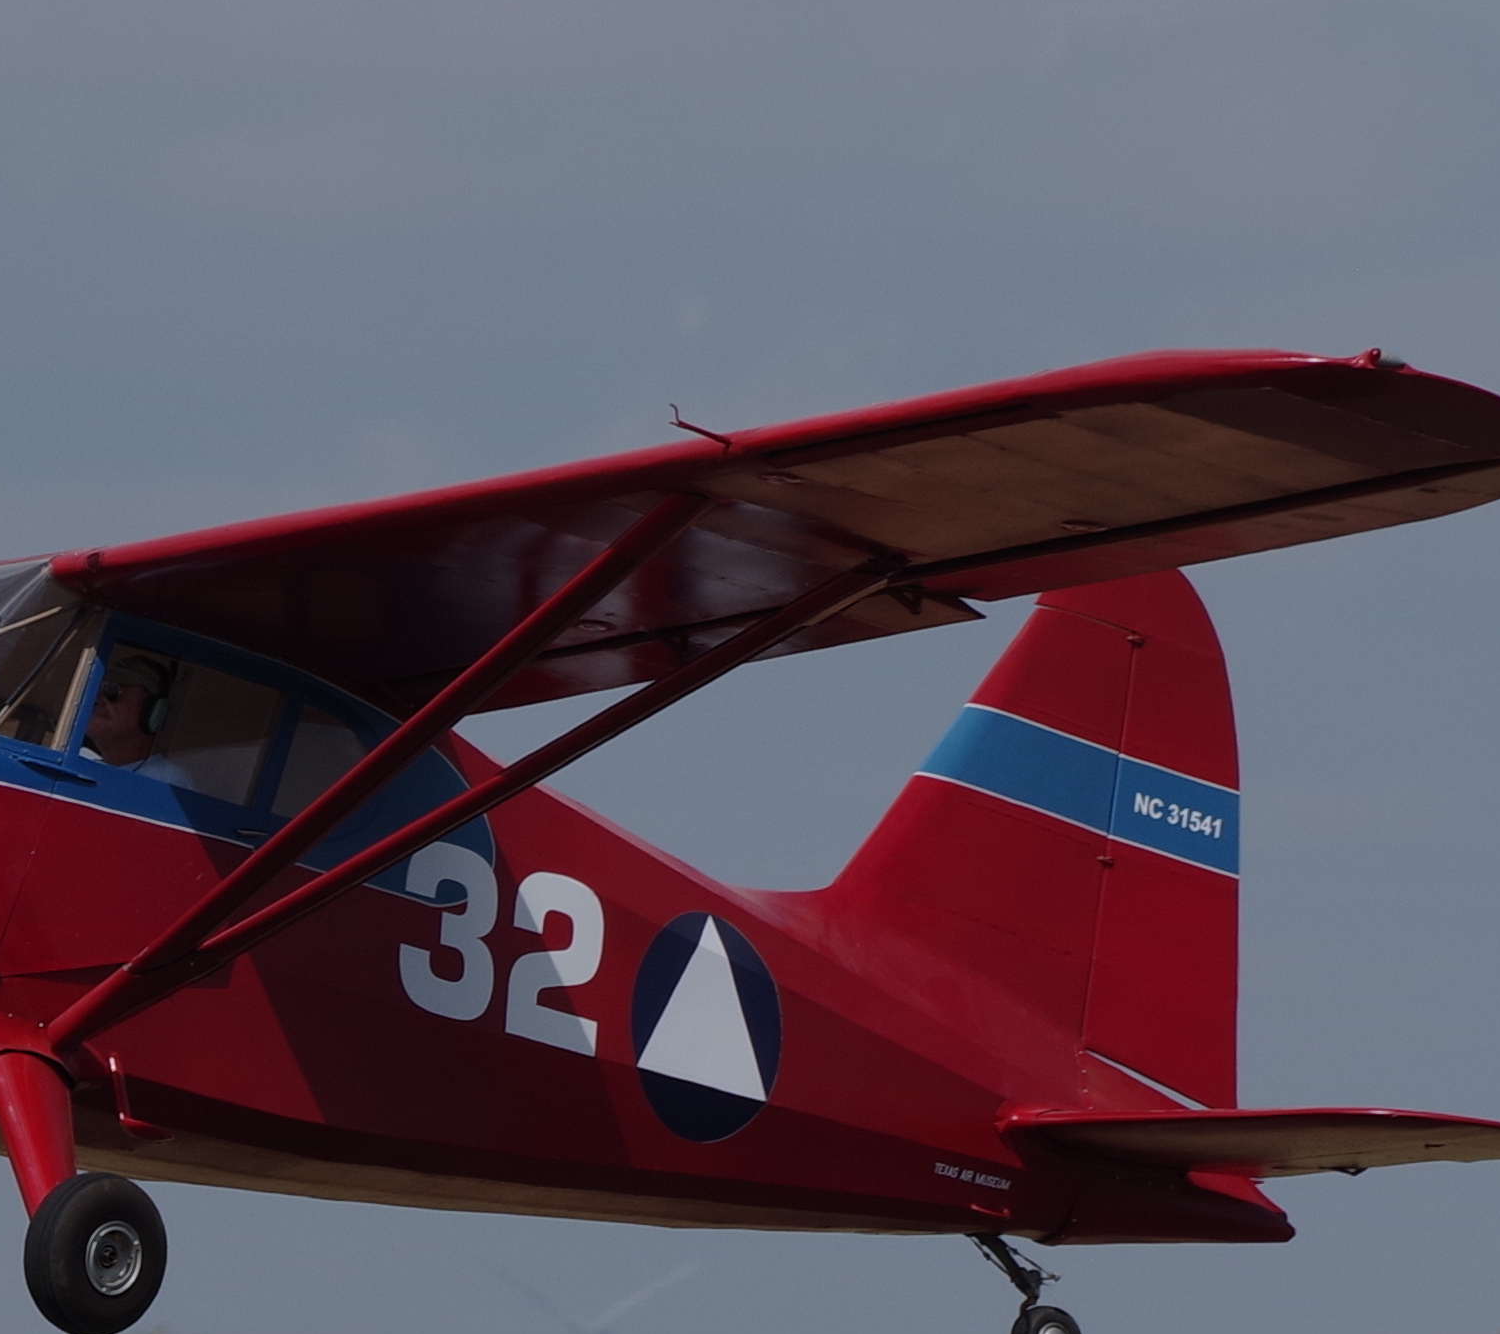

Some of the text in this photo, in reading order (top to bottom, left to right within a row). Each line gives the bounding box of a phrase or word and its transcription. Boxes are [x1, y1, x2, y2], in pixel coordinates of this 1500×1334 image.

[1133, 792, 1222, 839] NC 31541
[398, 840, 605, 1058] 32
[934, 1162, 1012, 1191] TEXAS AIR MUSEUM
